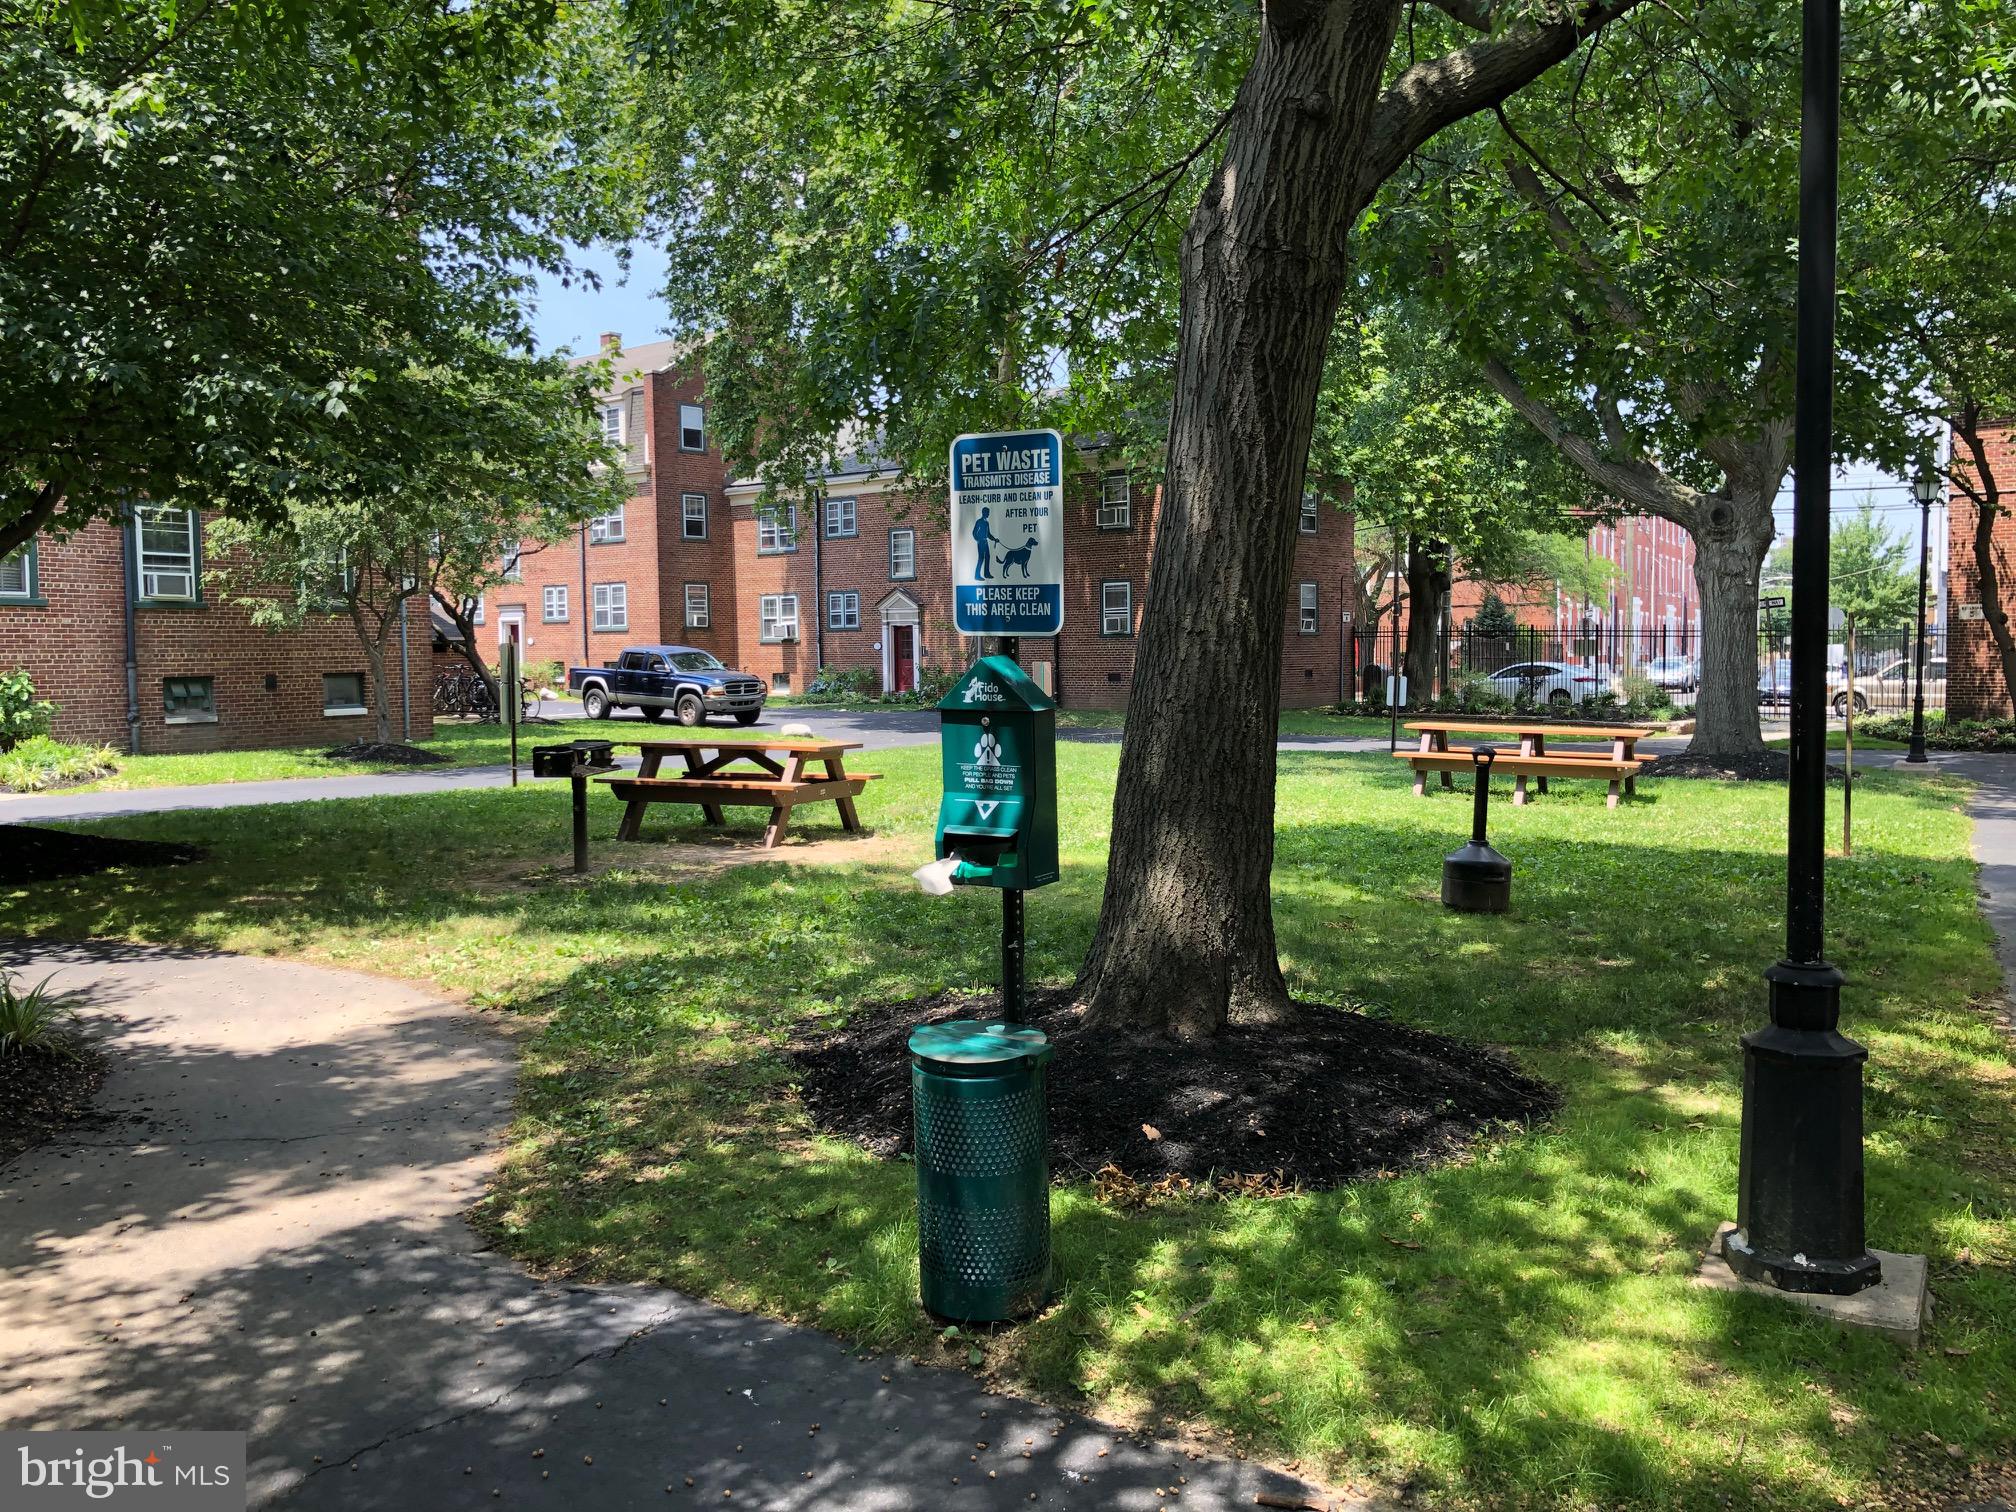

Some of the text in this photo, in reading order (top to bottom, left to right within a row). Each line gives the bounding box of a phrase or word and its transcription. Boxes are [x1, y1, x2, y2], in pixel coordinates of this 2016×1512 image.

[961, 448, 1050, 473] PET WASTE
[962, 472, 1050, 489] TRANSMITS DISEASE
[958, 490, 1053, 504] LEASH-CURB AND CLEAN UP
[1005, 506, 1049, 518] AFTER YOUR
[1022, 523, 1037, 533] PET
[976, 587, 1040, 601] PLEASE KEEP
[965, 602, 1051, 616] THIS AREA CLEAN
[978, 681, 999, 693] Fido
[974, 691, 1006, 702] House
